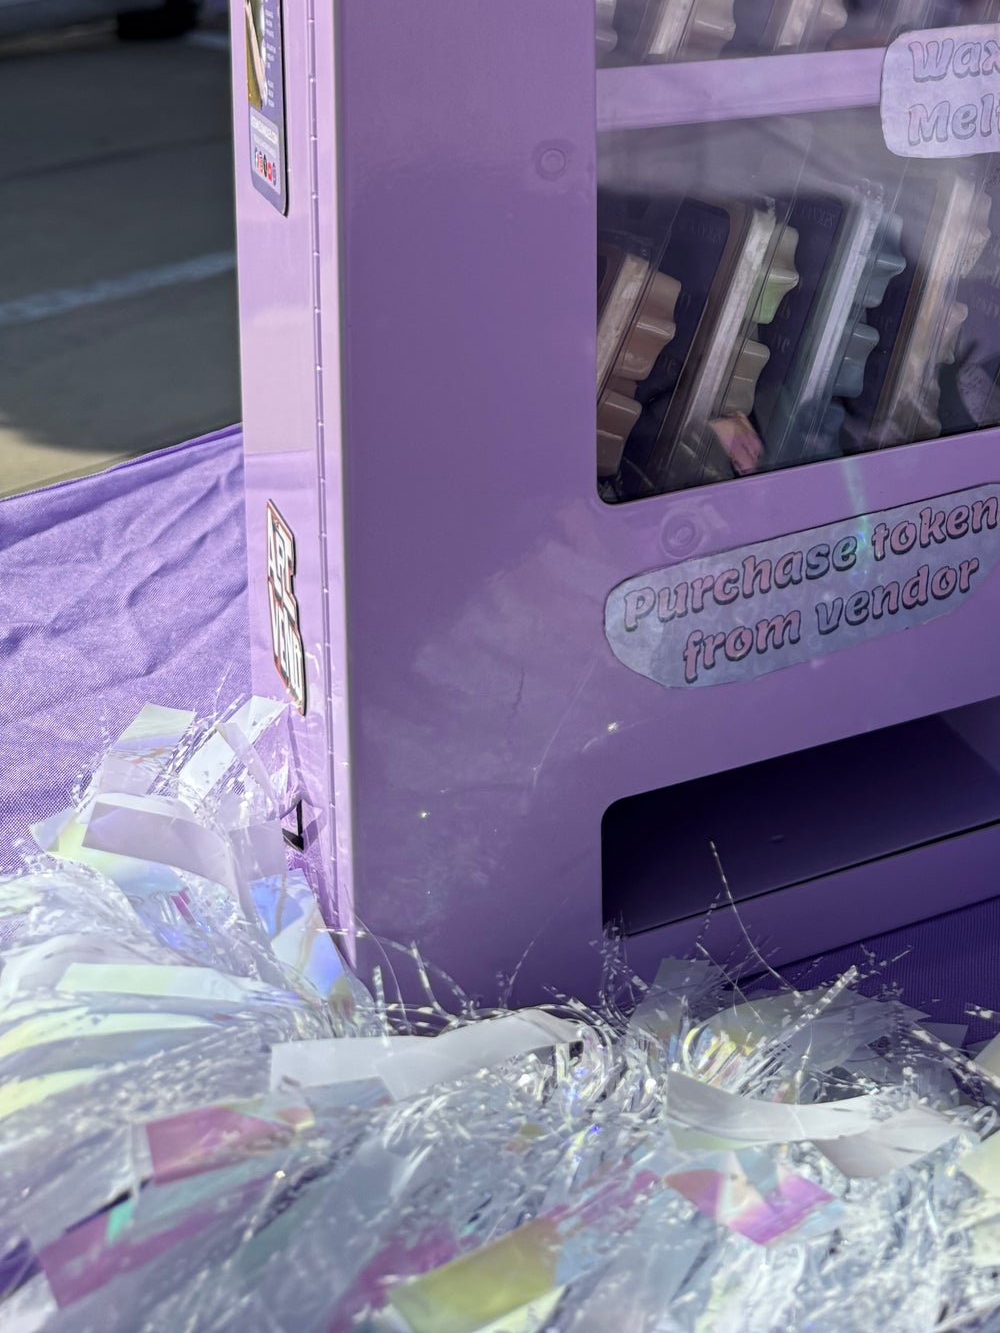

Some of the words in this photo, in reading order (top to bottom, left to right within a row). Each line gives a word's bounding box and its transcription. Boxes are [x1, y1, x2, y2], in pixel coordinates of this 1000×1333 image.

[622, 534, 858, 632] Purchase
[683, 609, 802, 684] from
[815, 556, 981, 635] vendor
